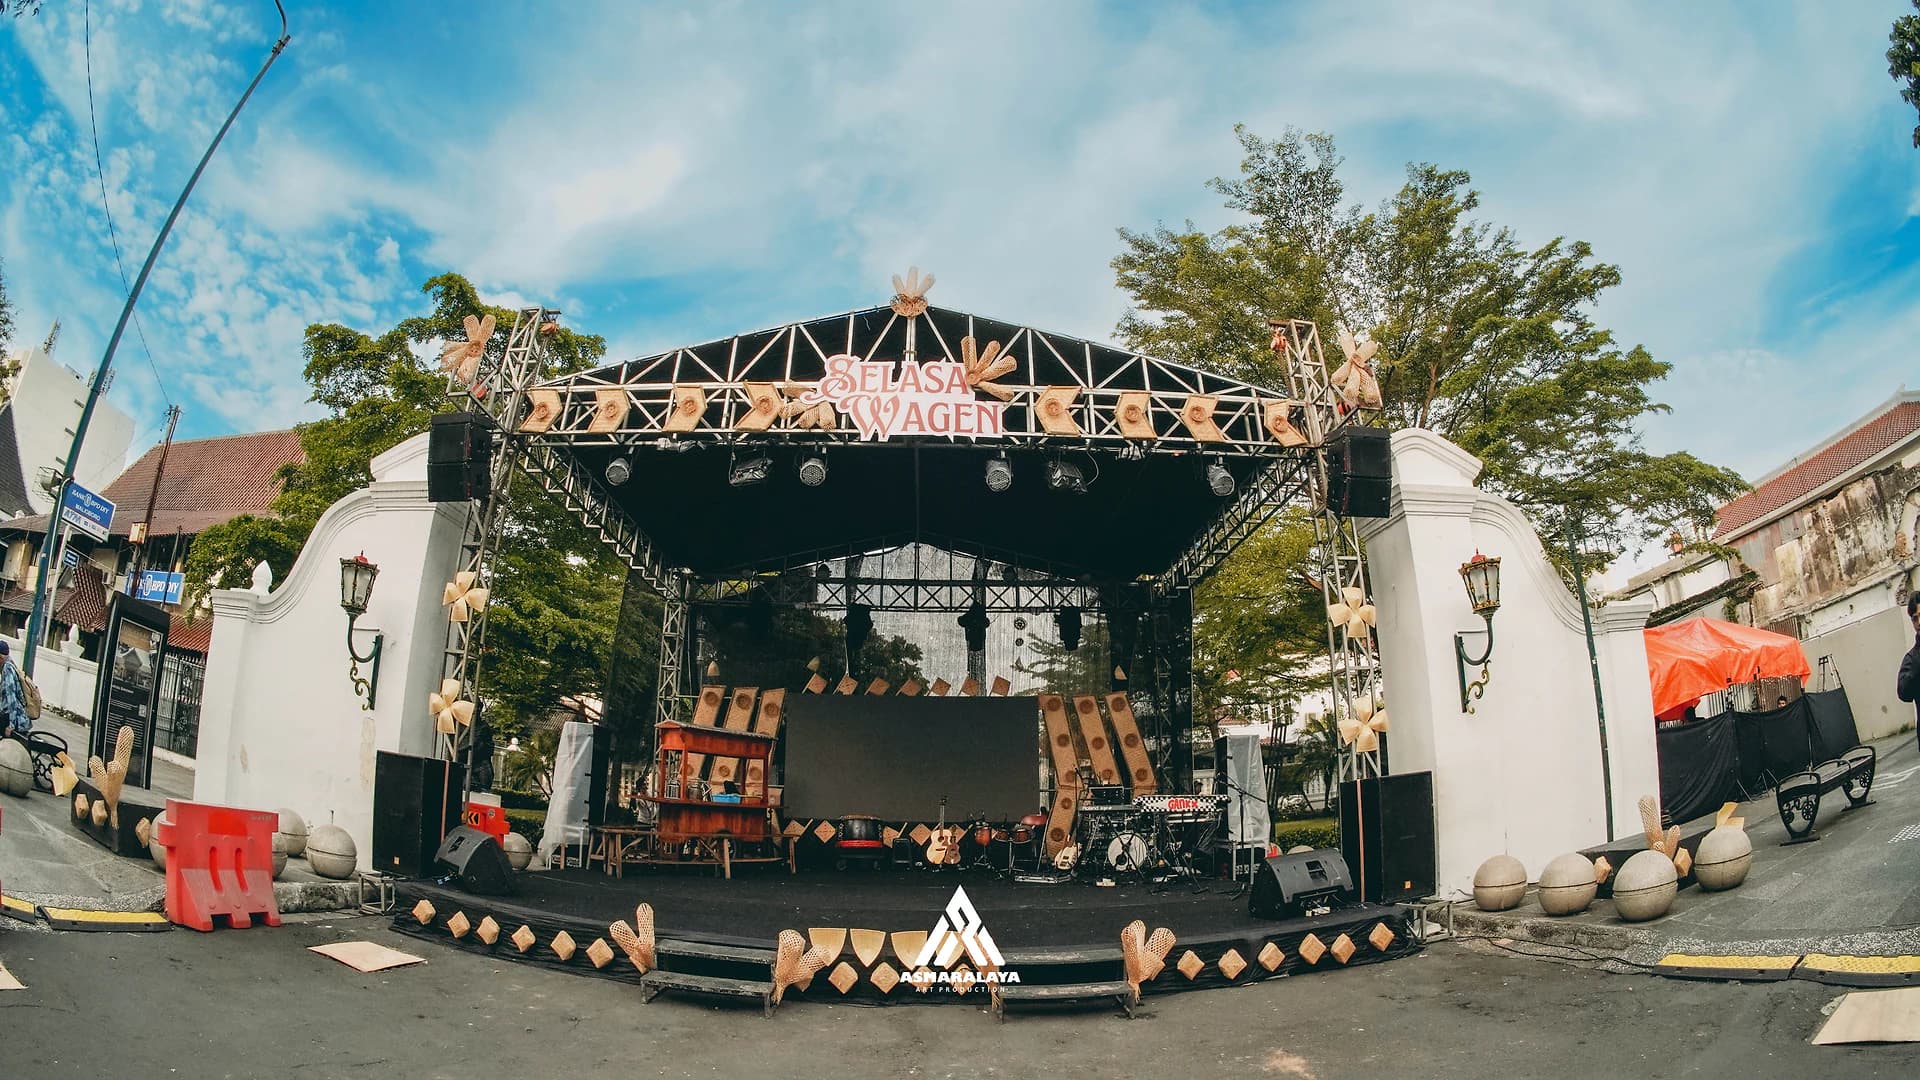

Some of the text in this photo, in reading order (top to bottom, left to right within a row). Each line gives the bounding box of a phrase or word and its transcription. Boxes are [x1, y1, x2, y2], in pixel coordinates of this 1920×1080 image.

[804, 357, 969, 400] SELASA
[840, 395, 998, 438] WAGEN
[151, 580, 166, 592] BPD
